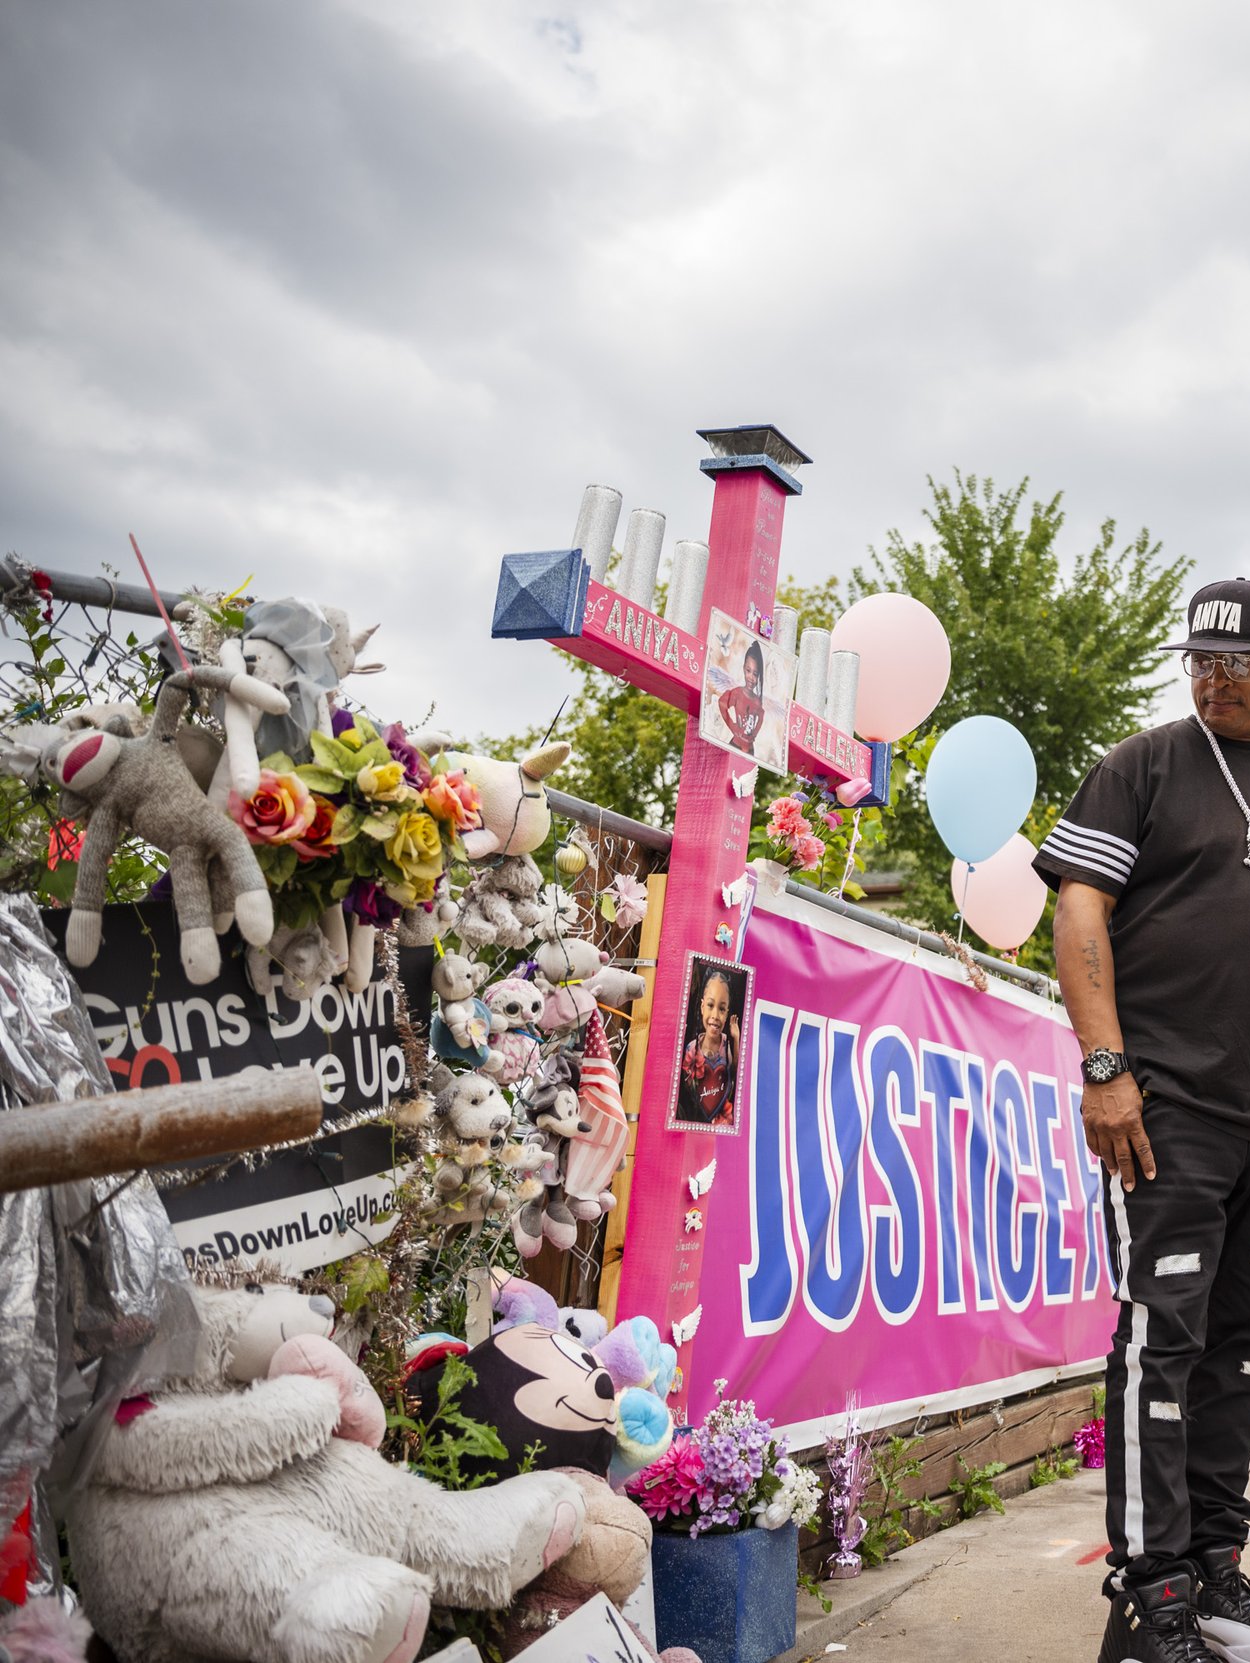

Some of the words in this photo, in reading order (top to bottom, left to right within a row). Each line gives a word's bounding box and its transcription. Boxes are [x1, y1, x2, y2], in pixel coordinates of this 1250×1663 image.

[604, 599, 680, 671] ANIYA
[1191, 600, 1242, 634] ANIYA
[803, 716, 859, 776] ALLEN
[83, 993, 251, 1059] Guns
[265, 974, 399, 1040] Down
[739, 998, 1077, 1338] JUSTICE
[181, 1190, 402, 1267] nsDownLoveUp.co
[677, 1258, 689, 1274] for
